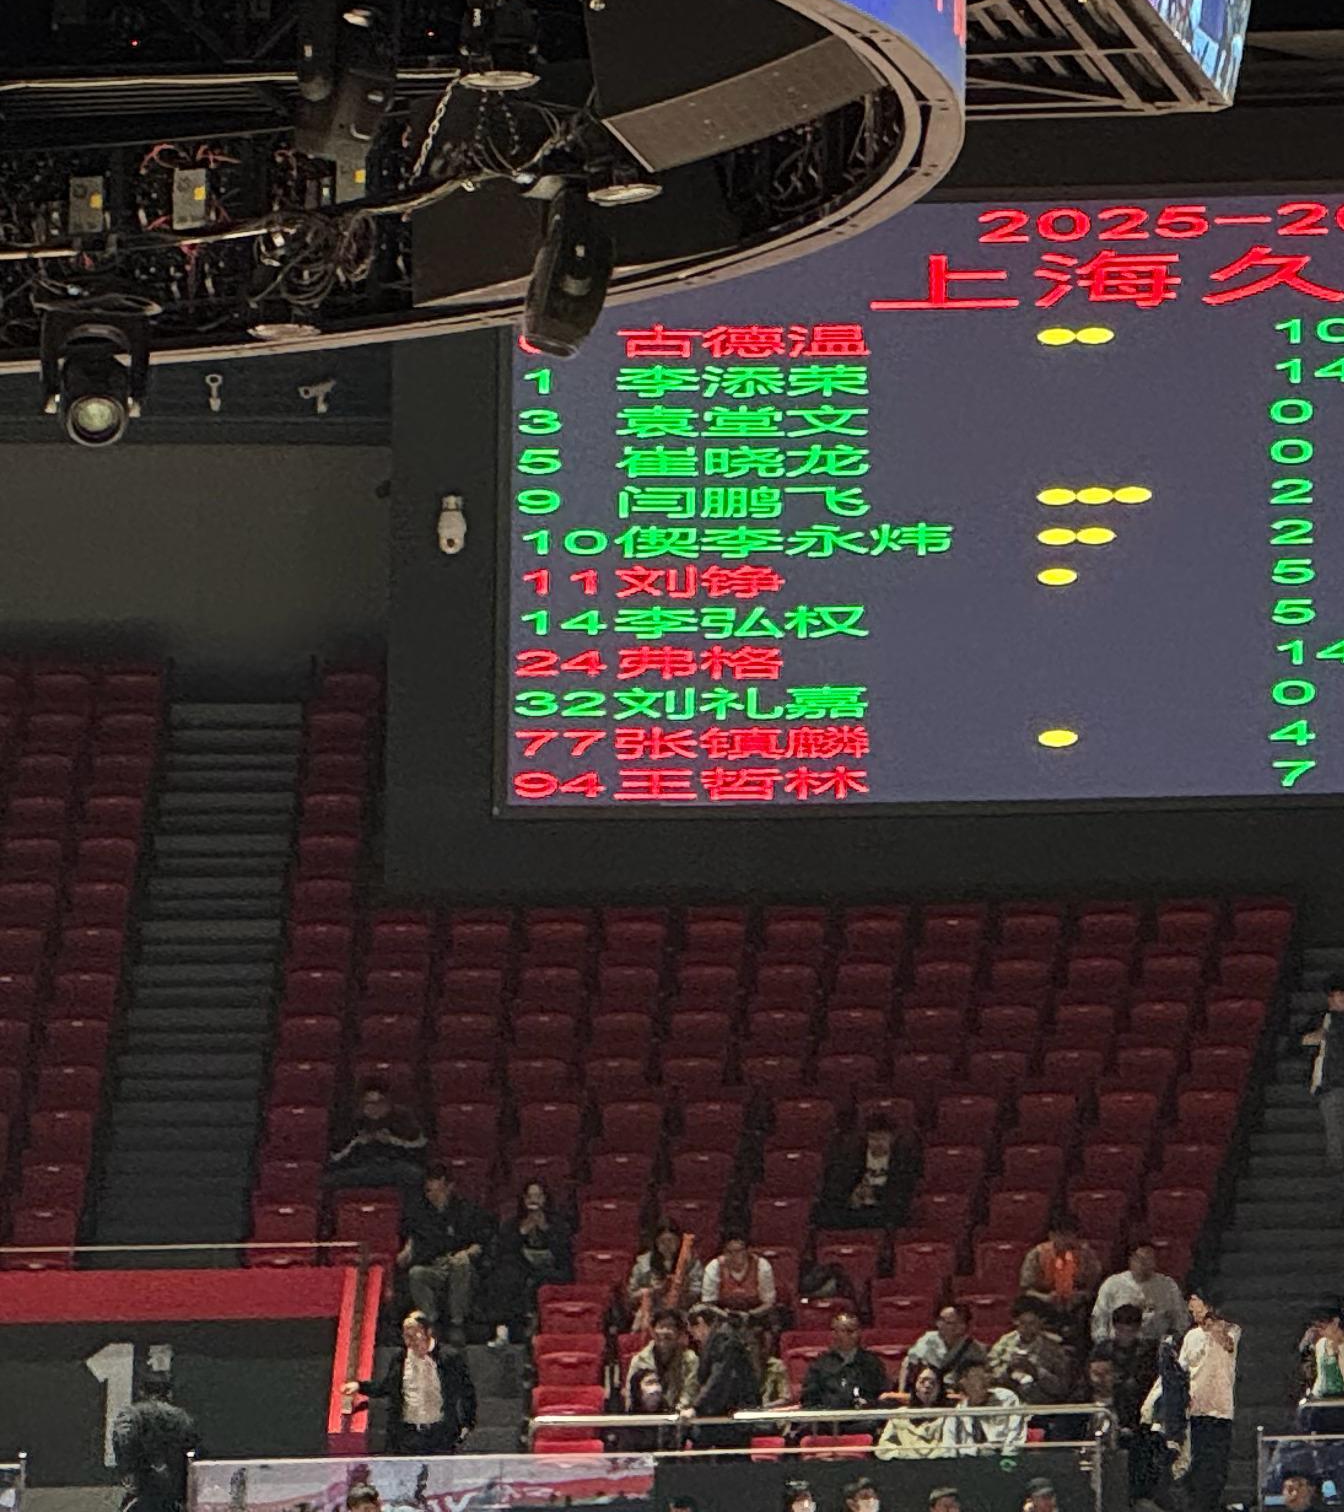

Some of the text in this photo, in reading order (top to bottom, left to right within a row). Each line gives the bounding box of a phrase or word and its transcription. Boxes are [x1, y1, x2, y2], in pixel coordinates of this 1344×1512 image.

[619, 323, 869, 358] 古德温
[528, 368, 551, 393] 1
[618, 363, 868, 398] 李添荣
[520, 398, 1314, 439] 3 袁堂文 0
[517, 438, 1314, 479] 5 崔晓龙 0
[516, 478, 1312, 519] 9 闫鹏飞 2
[526, 529, 609, 555] 10
[1272, 518, 1313, 545] 2
[524, 558, 1315, 599] 11 刘铮 5
[523, 598, 1316, 640] 14 李弘权 5
[515, 649, 606, 677] 24
[618, 645, 782, 680] 弗格
[515, 679, 1316, 720] 32 刘礼嘉 0
[517, 728, 605, 756] 77
[1270, 719, 1314, 745] 4
[513, 760, 1315, 801] 94 王哲林 7
